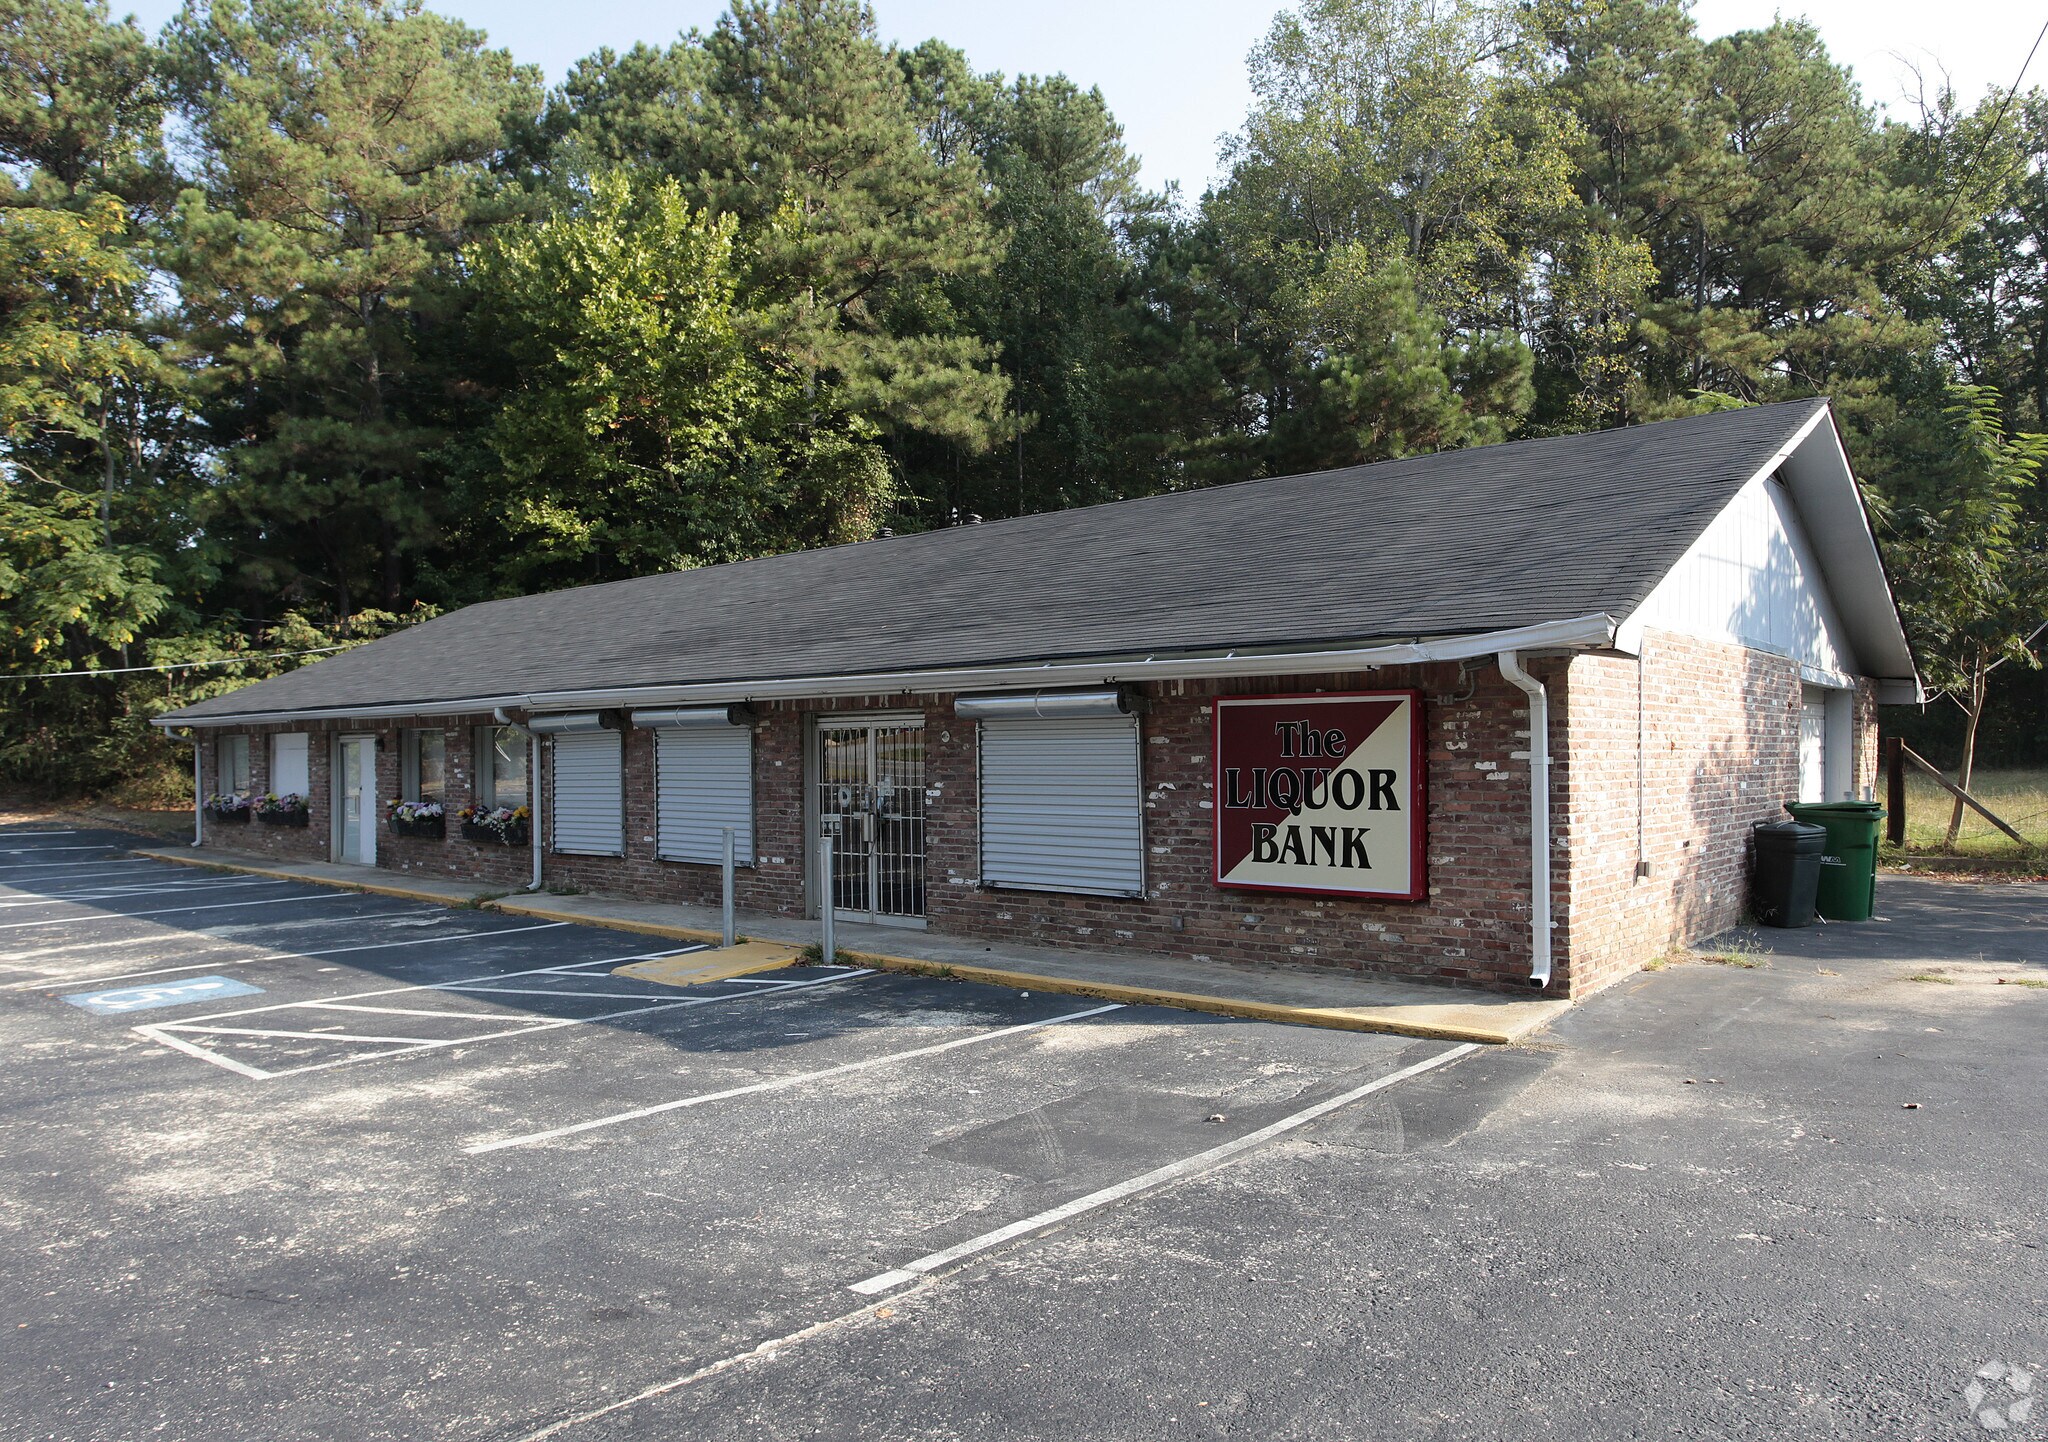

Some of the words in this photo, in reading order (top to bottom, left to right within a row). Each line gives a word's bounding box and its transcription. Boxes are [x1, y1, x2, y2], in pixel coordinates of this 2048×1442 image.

[1275, 720, 1346, 757] The
[1225, 767, 1401, 816] LIQUOR
[1251, 823, 1372, 869] BANK
